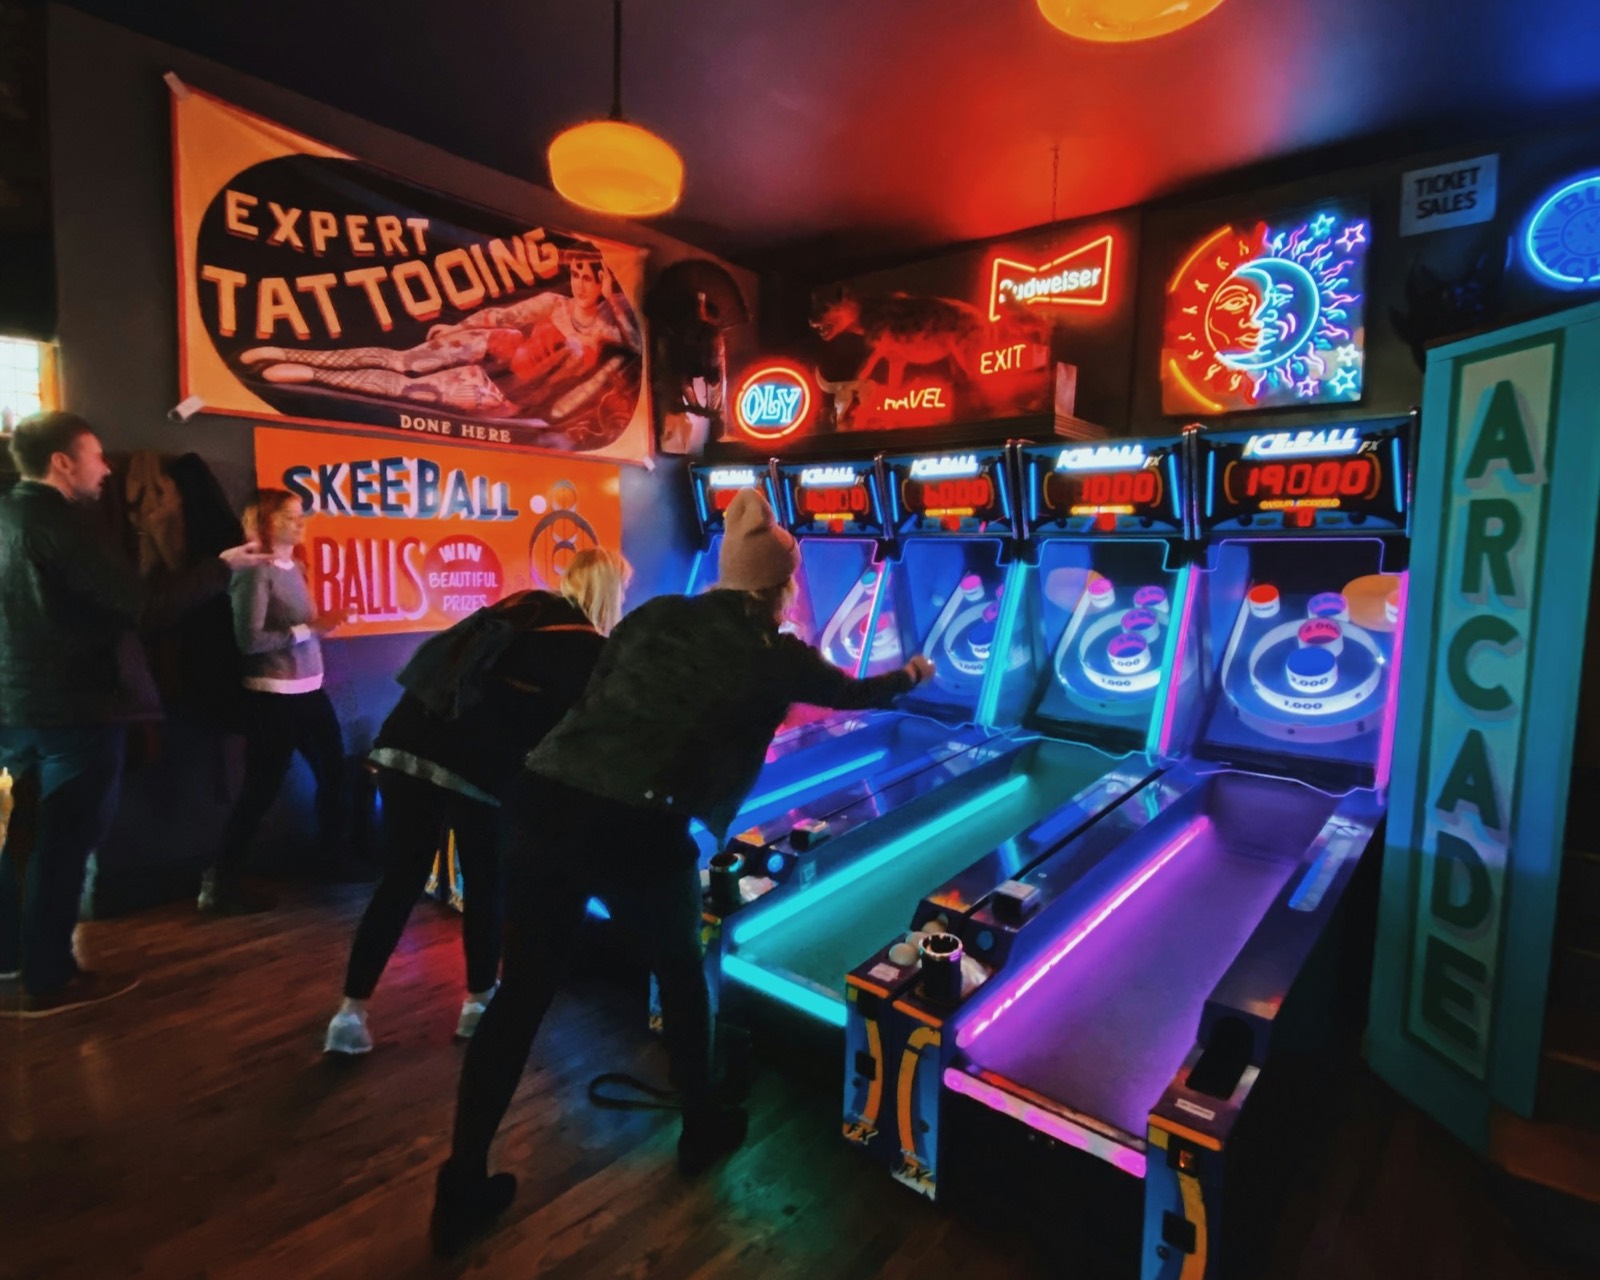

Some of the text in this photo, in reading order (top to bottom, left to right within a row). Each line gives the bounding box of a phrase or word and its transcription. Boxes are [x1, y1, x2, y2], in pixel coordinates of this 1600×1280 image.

[1414, 166, 1480, 197] TICKET
[1416, 190, 1477, 219] SALES
[225, 190, 429, 257] EXPERT
[202, 227, 559, 340] TATTOOING
[980, 344, 1026, 374] EXIT
[741, 384, 802, 425] OLY
[399, 414, 512, 443] DONE HERE
[1357, 439, 1382, 454] FX
[1246, 459, 1371, 497] 19000
[439, 542, 483, 563] WIN
[313, 536, 428, 623] BALLS
[428, 571, 499, 589] BEAUTIFUL
[442, 593, 489, 612] PRIZES
[1284, 699, 1322, 709] 1,000
[1421, 379, 1540, 1057] ARCADE
